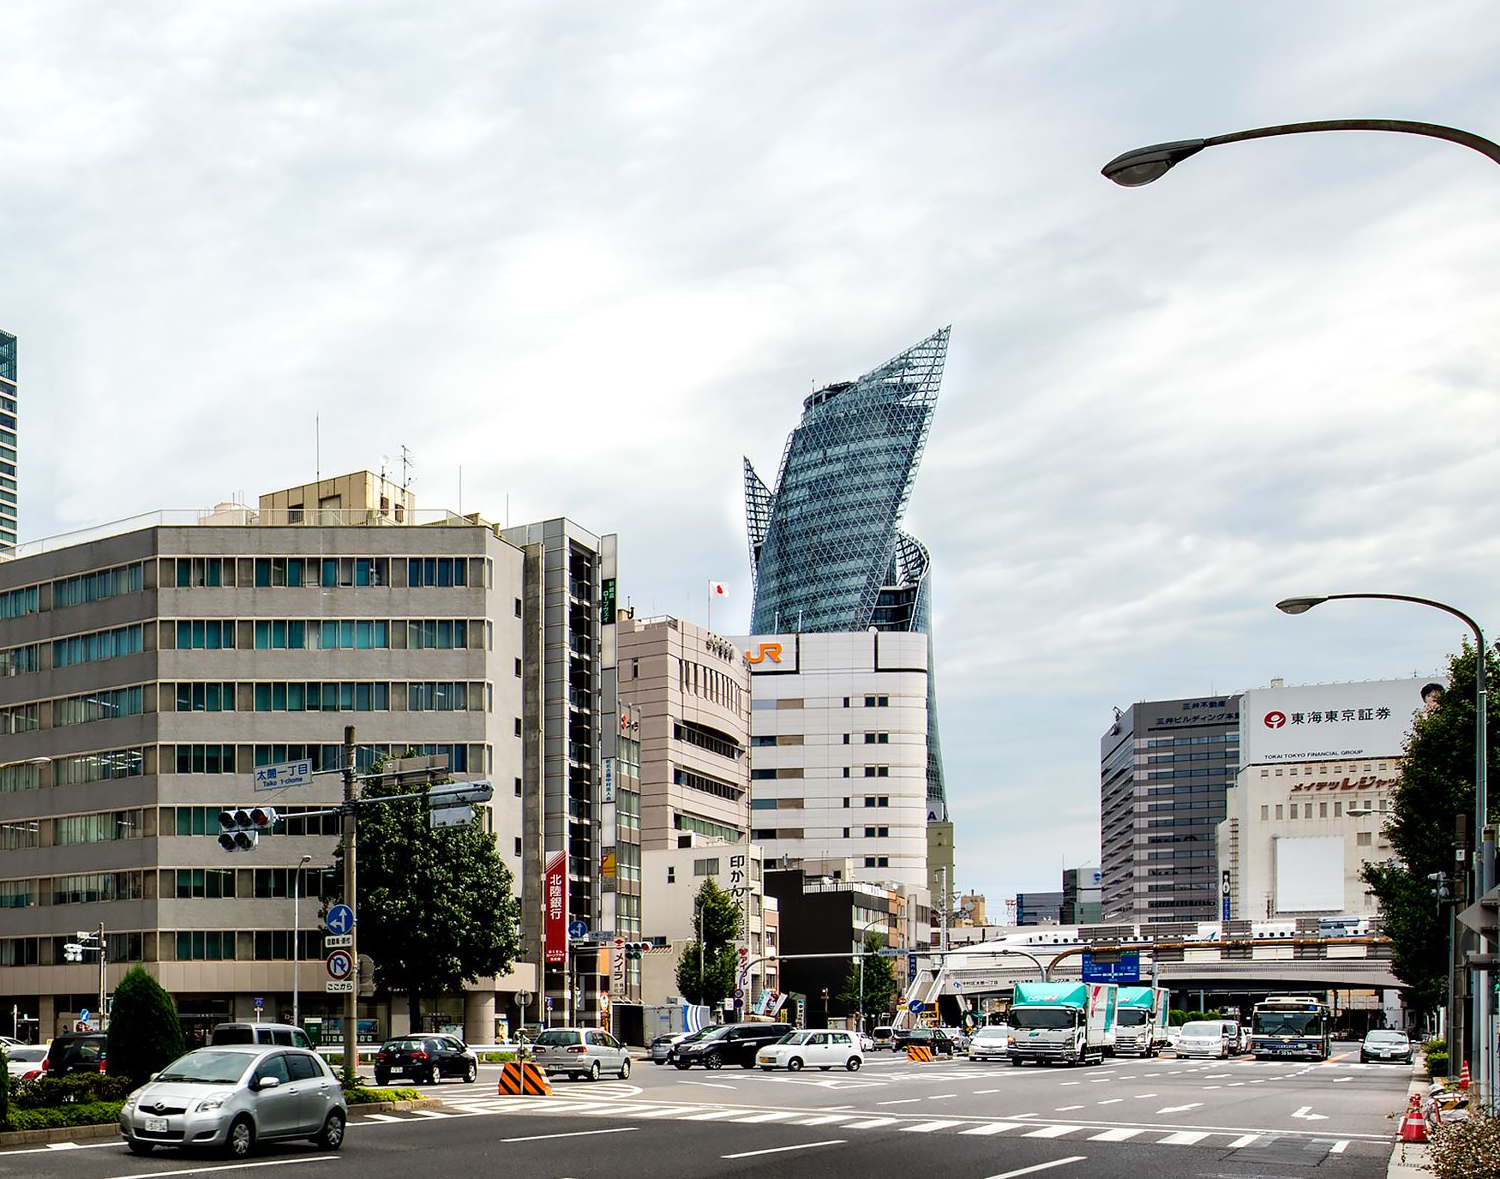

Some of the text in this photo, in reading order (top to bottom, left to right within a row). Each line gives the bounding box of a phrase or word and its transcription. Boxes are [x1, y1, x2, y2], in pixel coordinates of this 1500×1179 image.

[745, 643, 783, 664] JR
[1182, 700, 1226, 710] 三井不動産
[1290, 706, 1392, 725] 東海東京証券
[257, 763, 308, 781] 太閤一丁目
[550, 874, 562, 920] 北陸銀行
[327, 983, 353, 991] ここから
